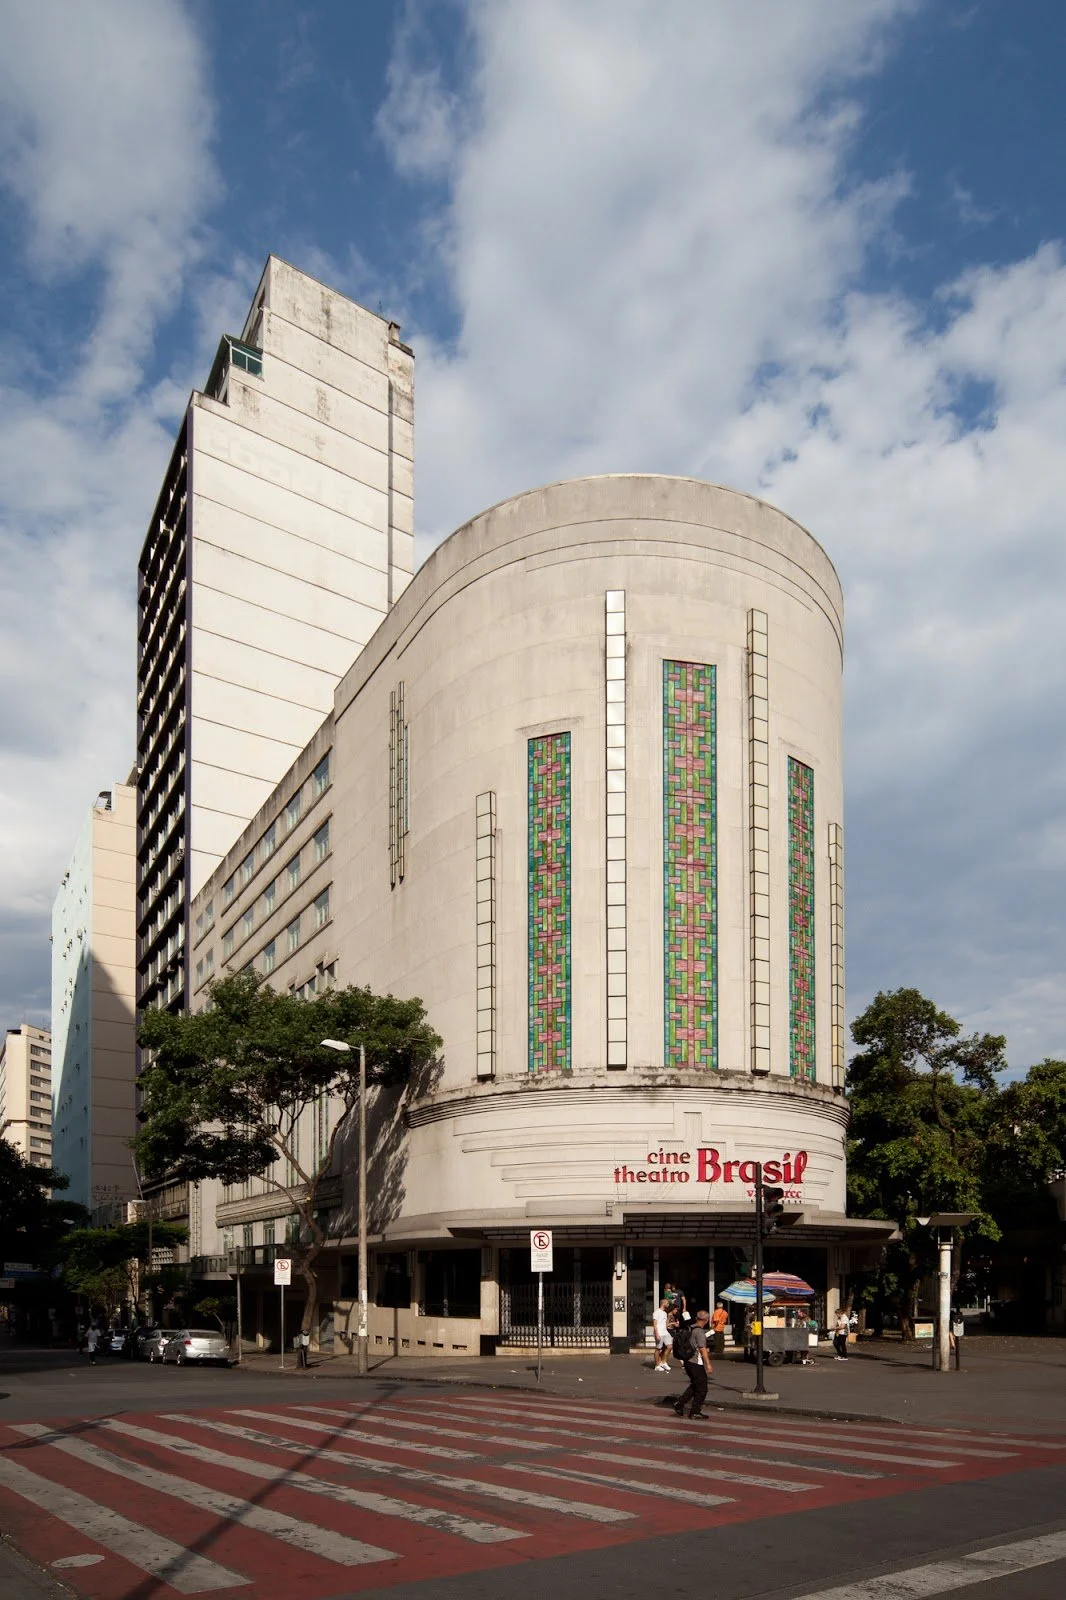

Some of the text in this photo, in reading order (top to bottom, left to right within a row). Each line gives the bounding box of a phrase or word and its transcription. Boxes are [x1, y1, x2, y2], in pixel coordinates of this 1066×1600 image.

[614, 1148, 808, 1184] theatro Brasil
[647, 1148, 691, 1164] cine
